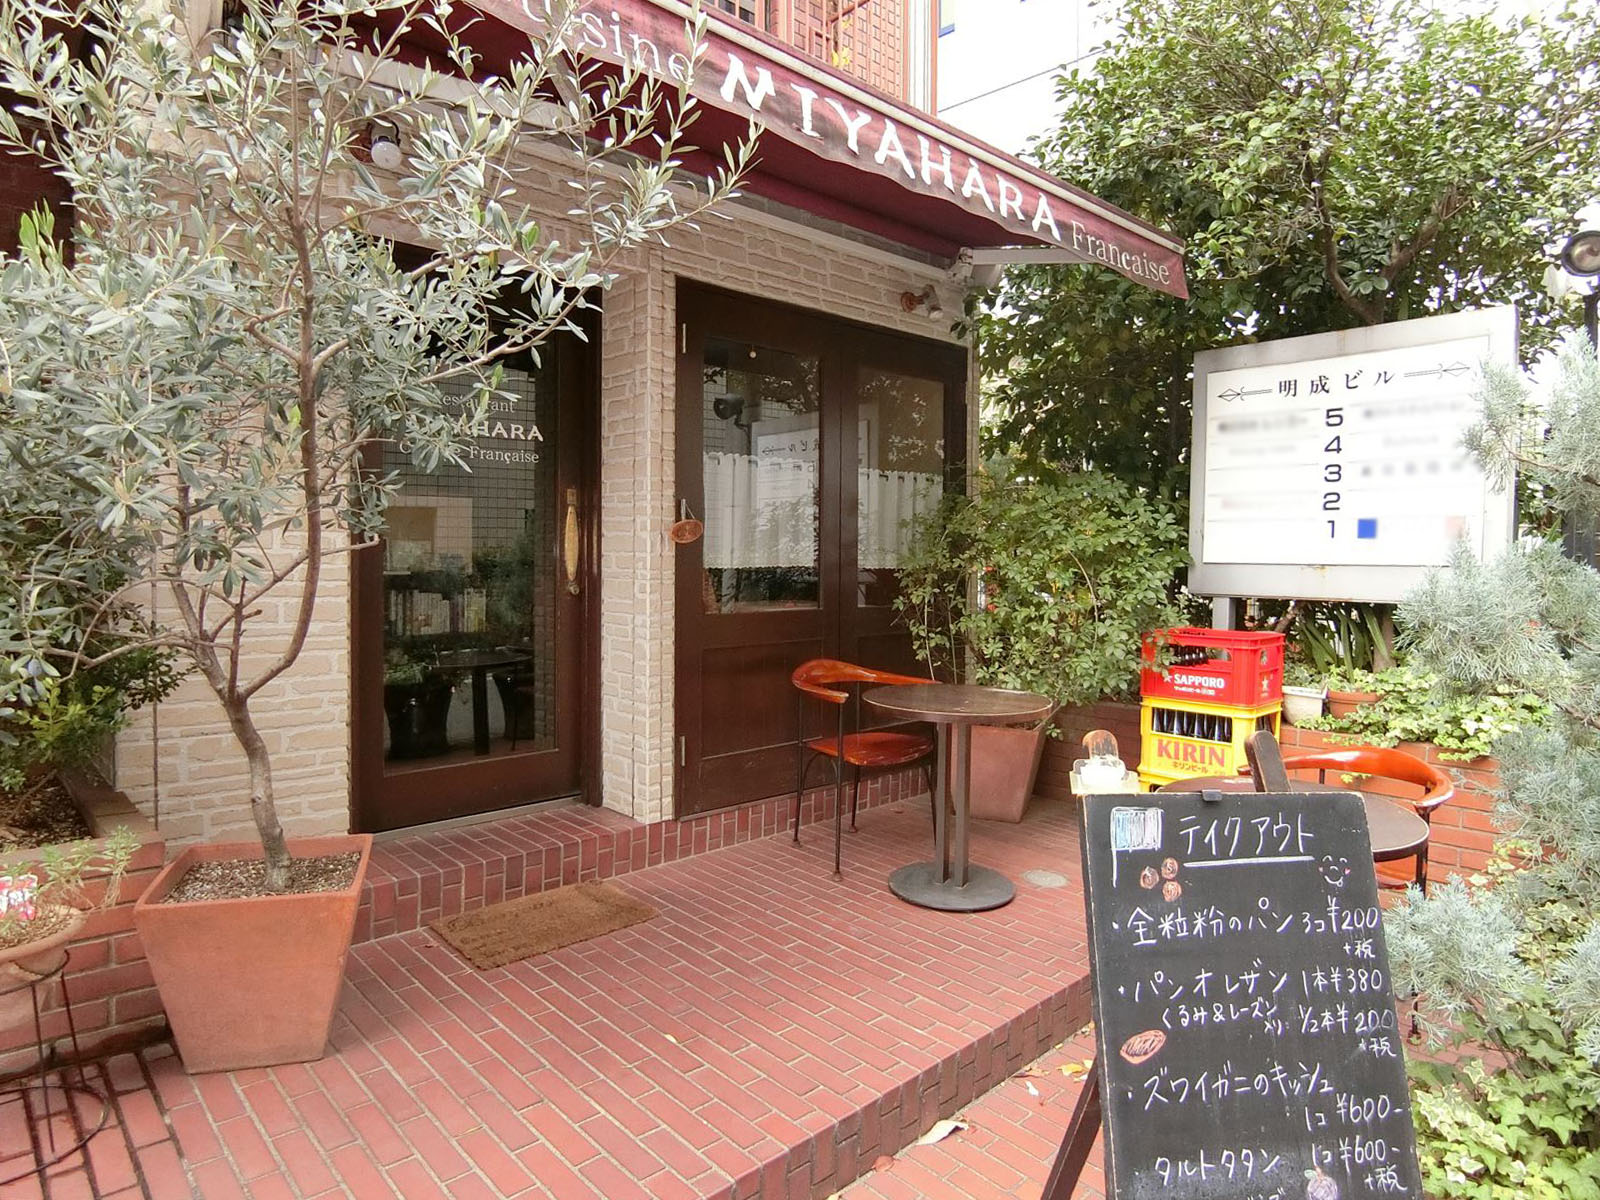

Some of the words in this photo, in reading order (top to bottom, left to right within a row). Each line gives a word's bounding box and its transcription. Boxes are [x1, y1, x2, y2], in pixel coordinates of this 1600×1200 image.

[1278, 369, 1395, 397] 明成ビル
[443, 393, 516, 414] esaurant
[1325, 408, 1344, 427] 5
[1324, 435, 1342, 454] 4
[469, 446, 540, 463] Française
[1324, 464, 1342, 482] 3
[1323, 492, 1341, 510] 2
[1327, 520, 1335, 538] 1
[1174, 673, 1225, 689] SAPPORO
[1157, 738, 1225, 767] KIRIN
[1179, 812, 1314, 856] テイクアウト
[1144, 1061, 1334, 1111] ズワイガニのキッシュ
[1154, 1148, 1281, 1185] タルトタタン
